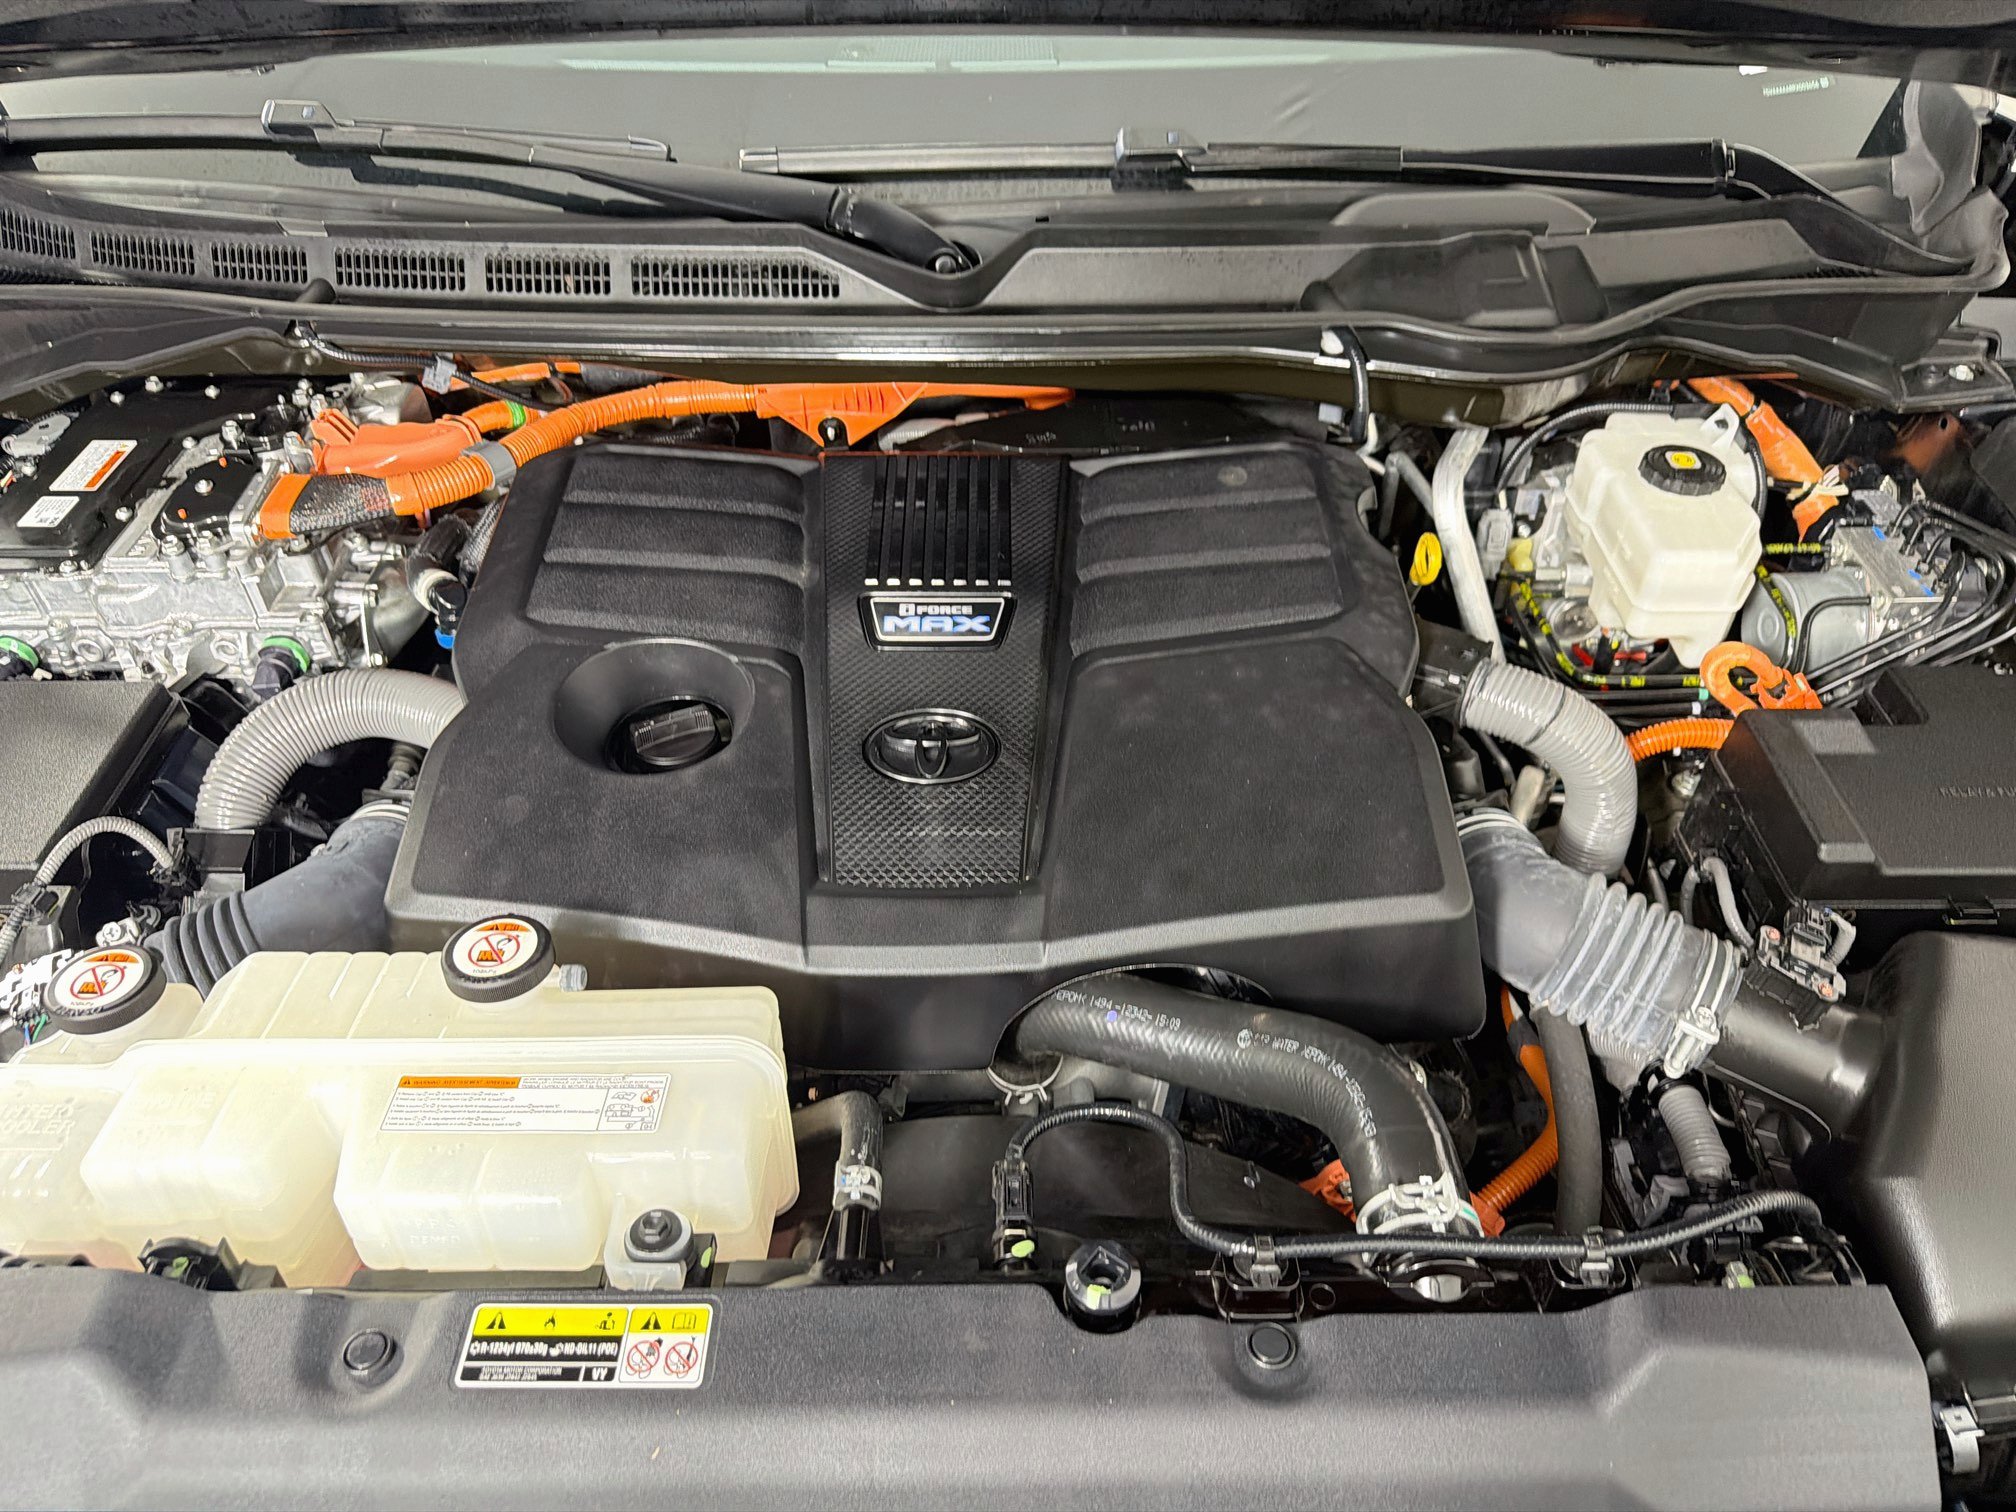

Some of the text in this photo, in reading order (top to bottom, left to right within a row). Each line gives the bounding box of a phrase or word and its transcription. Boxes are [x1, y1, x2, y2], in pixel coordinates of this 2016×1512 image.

[917, 604, 973, 615] FORCE
[883, 615, 991, 633] MAX
[0, 1119, 76, 1135] OOLER
[592, 1367, 608, 1381] VY
